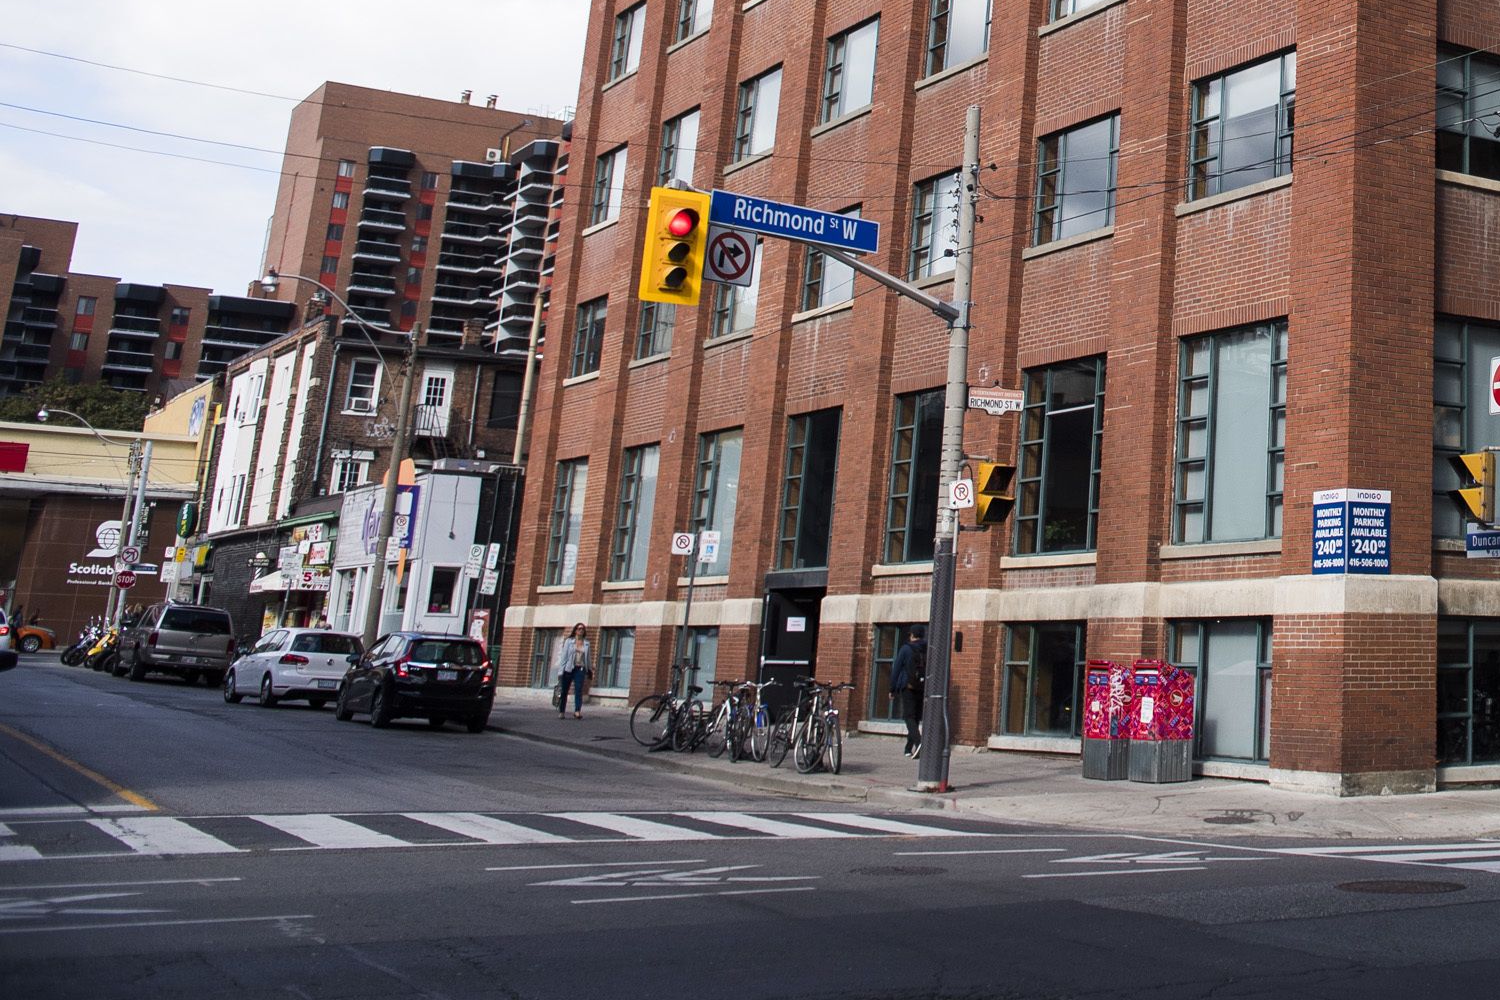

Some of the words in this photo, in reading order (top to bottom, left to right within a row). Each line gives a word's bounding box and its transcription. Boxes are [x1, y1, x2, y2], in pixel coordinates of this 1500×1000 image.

[734, 198, 824, 234] Richmond
[830, 217, 838, 229] St
[842, 220, 857, 240] W
[970, 398, 1003, 408] RICHMOND
[1358, 492, 1381, 500] INDIGO
[1317, 508, 1342, 518] MONTHLY
[1353, 507, 1385, 516] MONTHLY
[1318, 518, 1341, 528] PARKING
[1354, 518, 1384, 527] PARKING
[1315, 528, 1343, 538] AVAILABLE
[1351, 528, 1387, 537] AVAILABLE
[1314, 558, 1344, 568] 416-506-1000
[1349, 559, 1388, 567] 416-506-1000
